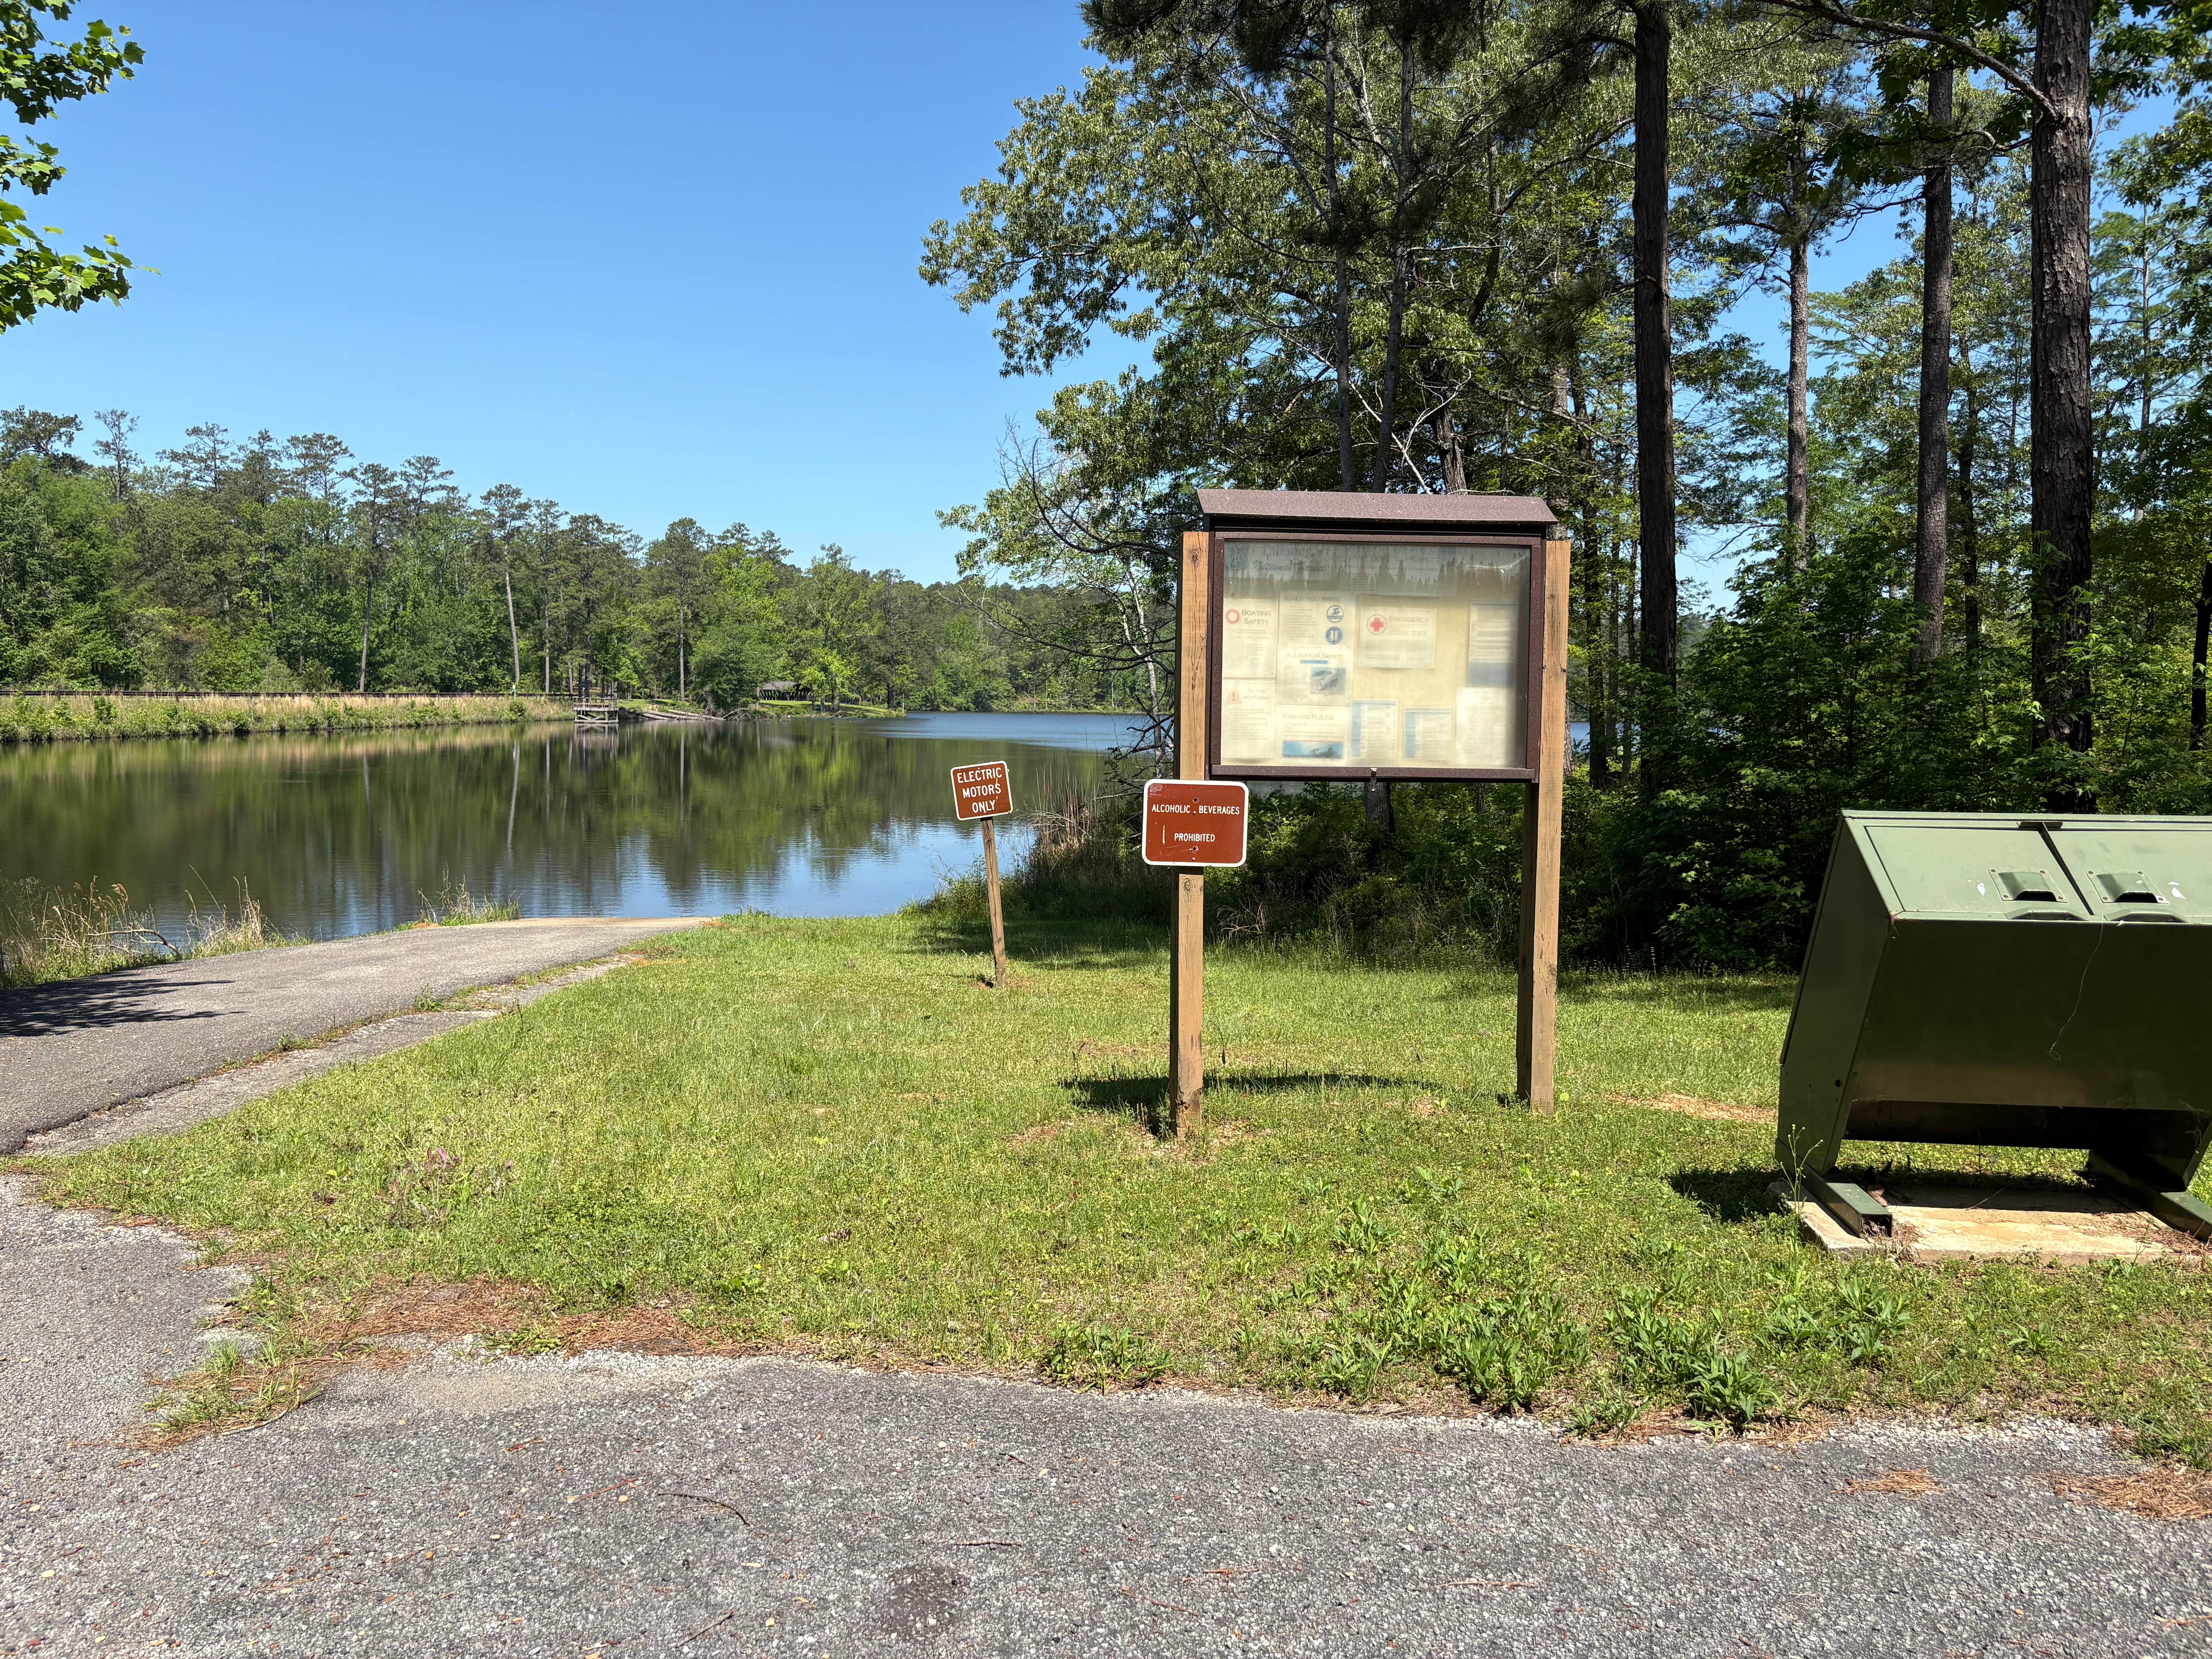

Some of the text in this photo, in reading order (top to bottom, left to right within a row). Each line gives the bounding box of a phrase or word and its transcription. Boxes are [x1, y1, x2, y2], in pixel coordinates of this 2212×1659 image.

[957, 767, 1002, 783] ELECTRIC
[962, 783, 1001, 799] MOTORS
[972, 800, 995, 813] ONLY
[1151, 804, 1240, 815] ALCOHOLIC BEVERAGES
[1174, 833, 1215, 842] PROHIBITED
